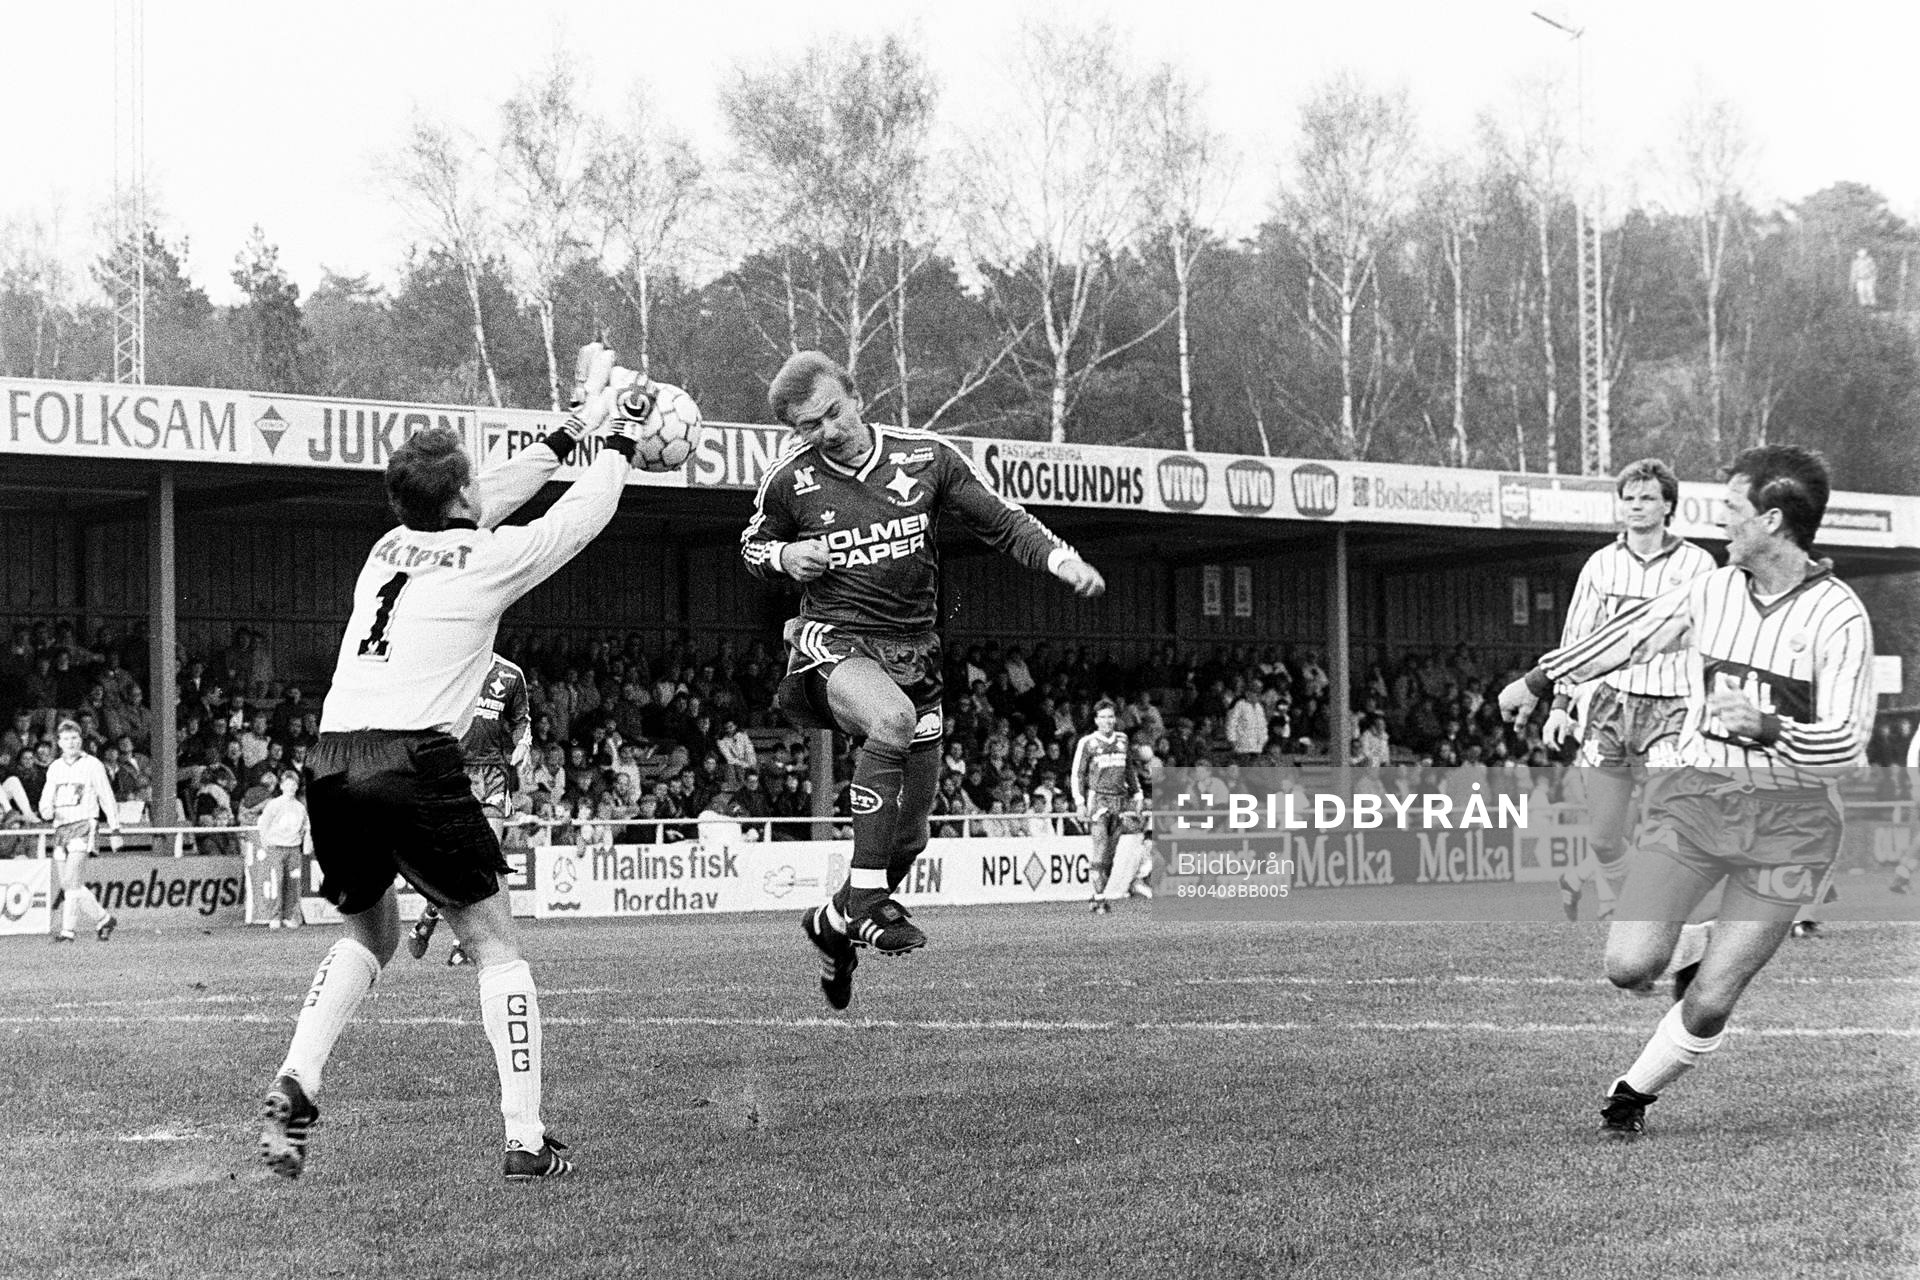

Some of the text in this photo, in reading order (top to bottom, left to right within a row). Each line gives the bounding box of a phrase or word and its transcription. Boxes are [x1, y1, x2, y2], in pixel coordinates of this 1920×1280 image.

[8, 390, 237, 453] FOLKSAM
[694, 426, 800, 486] SIN
[985, 444, 1144, 504] SKOGLUNDHS
[829, 534, 926, 571] PAPER
[357, 571, 409, 662] 1
[592, 846, 739, 881] Malins fisk
[982, 855, 1023, 886] NPL
[1293, 832, 1395, 888] Melka
[1416, 829, 1513, 883] Melka
[614, 886, 719, 912] Nordhav
[507, 994, 530, 1073] GDG
